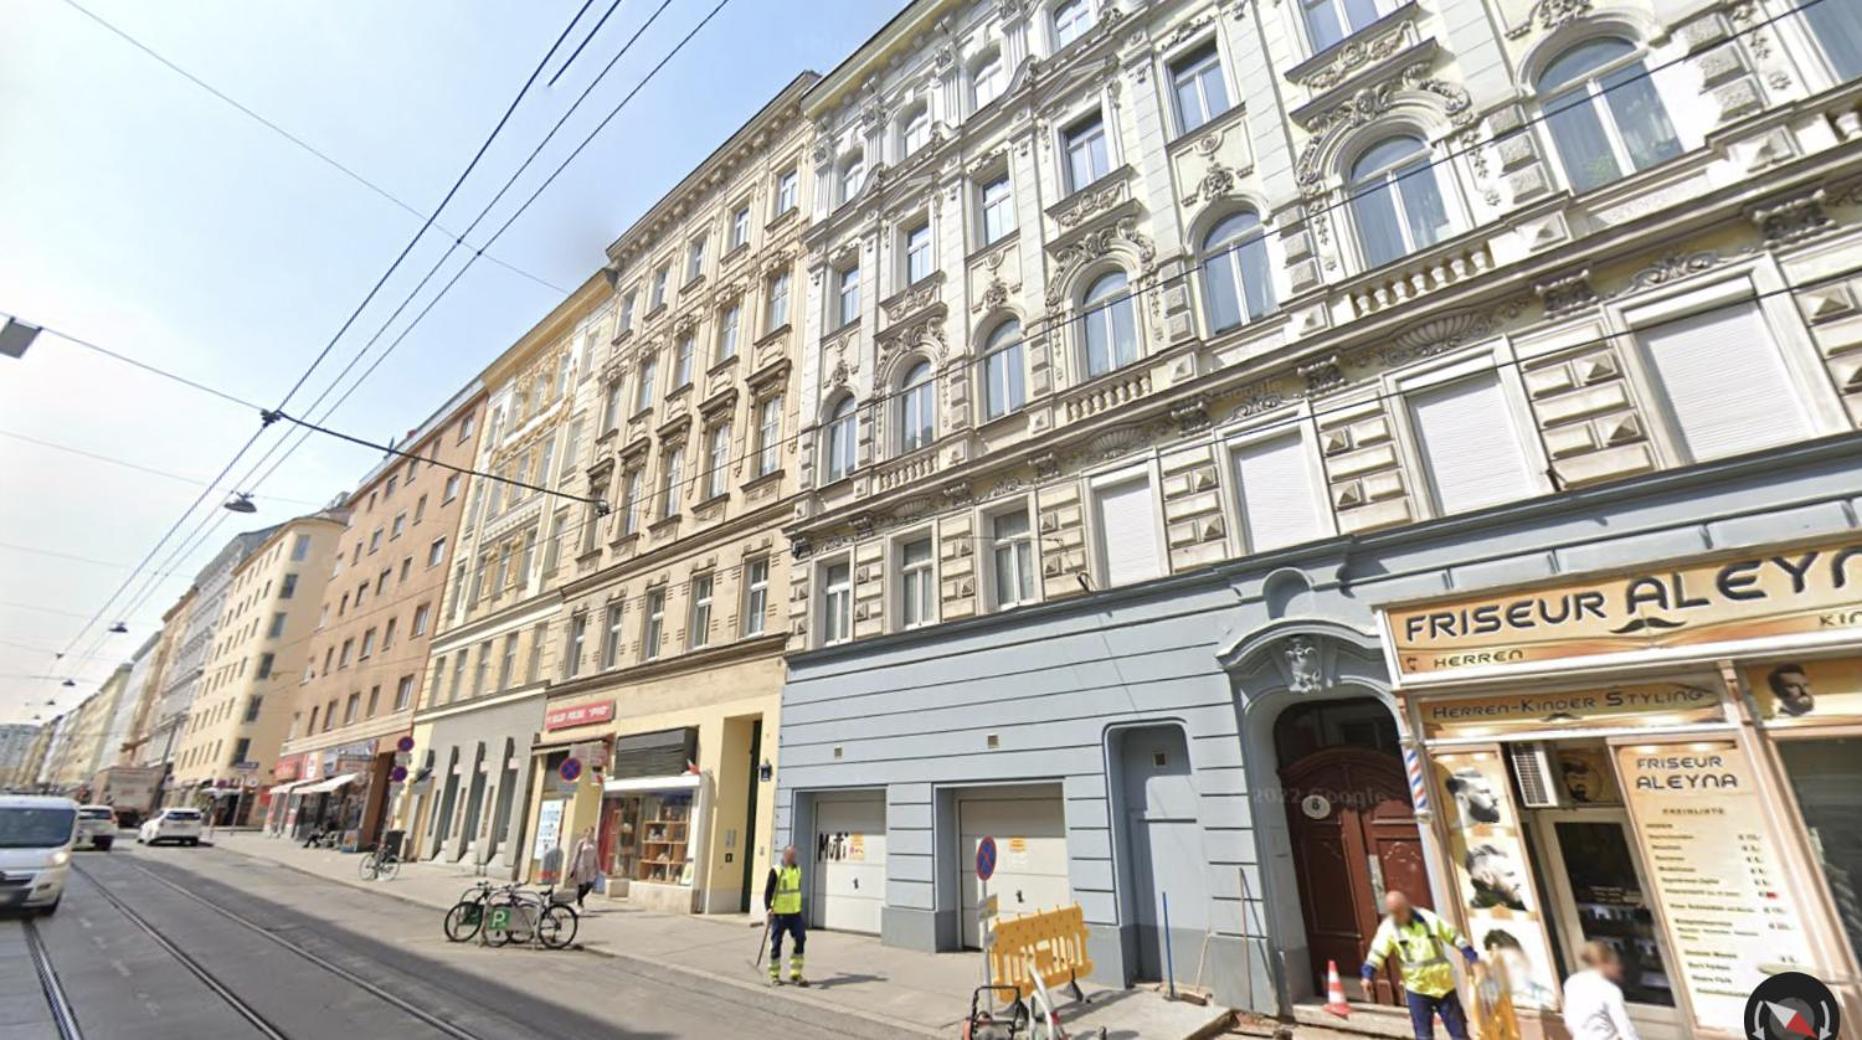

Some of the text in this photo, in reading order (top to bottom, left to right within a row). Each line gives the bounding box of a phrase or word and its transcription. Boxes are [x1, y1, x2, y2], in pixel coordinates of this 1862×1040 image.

[1406, 591, 1607, 641] FRISEUR
[1434, 649, 1524, 668] HERREN
[1636, 755, 1723, 769] FRISEUR
[1636, 773, 1738, 789] ALEYNA
[492, 909, 506, 928] P
